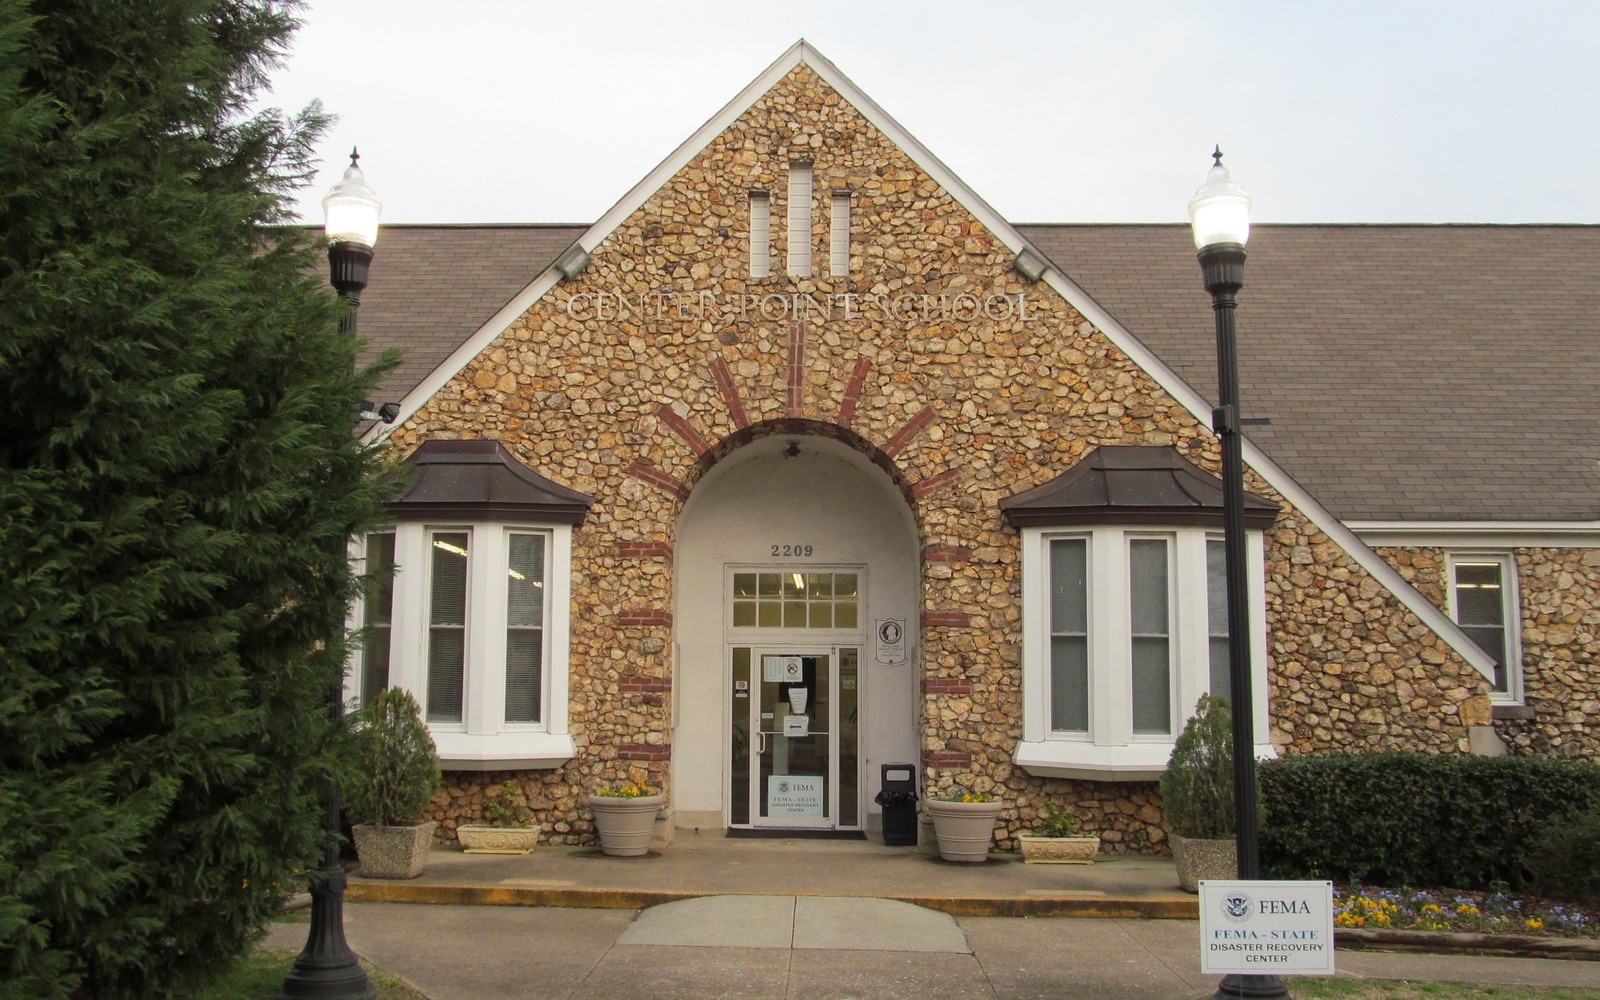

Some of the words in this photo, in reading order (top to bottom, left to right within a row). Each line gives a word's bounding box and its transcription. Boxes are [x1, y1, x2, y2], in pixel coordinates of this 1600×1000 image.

[566, 292, 724, 324] CENTER
[740, 293, 859, 322] POINT
[873, 293, 1038, 322] SCHOOL
[771, 545, 813, 557] 2209
[1259, 900, 1311, 914] FEMA
[1214, 930, 1258, 939] FEMA
[1271, 930, 1319, 939] STATE
[1210, 943, 1263, 951] DISASTER
[1266, 943, 1324, 951] RECOVERY
[1246, 955, 1288, 963] CENTER
